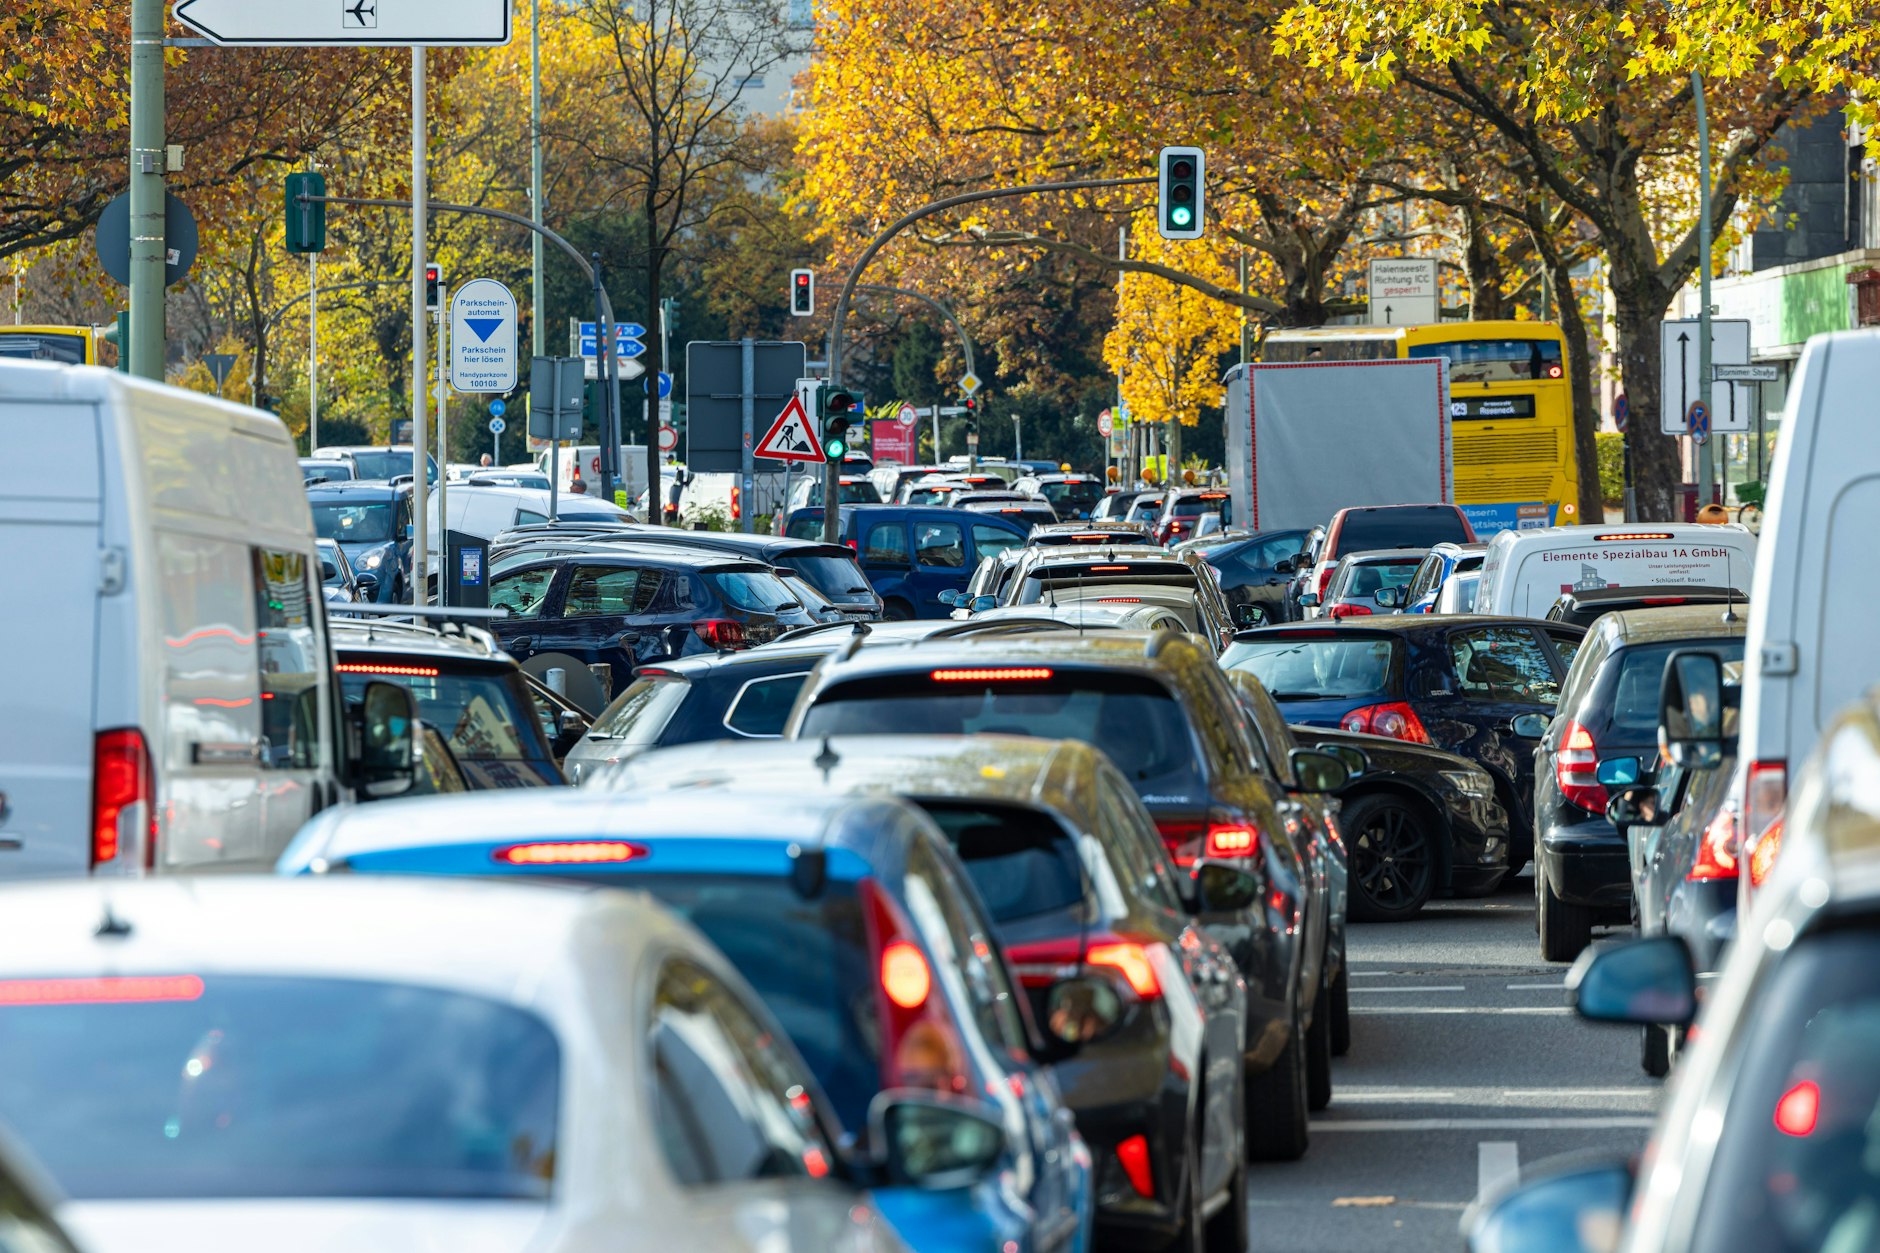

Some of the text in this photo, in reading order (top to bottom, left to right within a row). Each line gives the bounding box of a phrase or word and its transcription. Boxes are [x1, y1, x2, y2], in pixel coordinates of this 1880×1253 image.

[1374, 274, 1430, 286] Richtung ICC
[1383, 286, 1421, 296] gesperrt
[464, 355, 504, 363] hier lösen
[901, 411, 912, 421] 30
[1542, 548, 1727, 562] Elemente Spezialbau 1A GmbH
